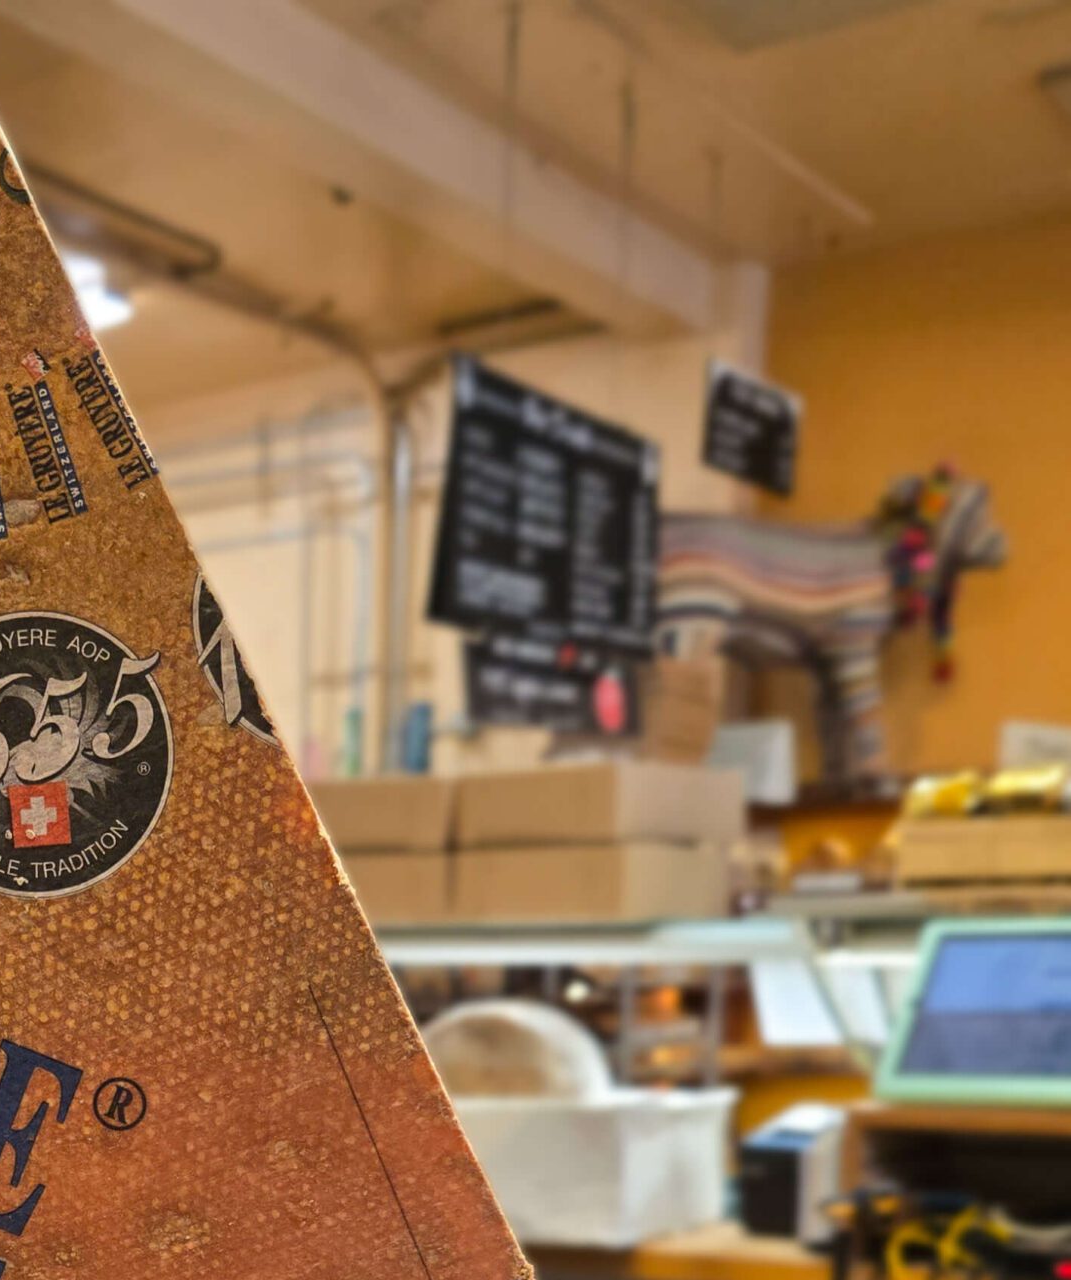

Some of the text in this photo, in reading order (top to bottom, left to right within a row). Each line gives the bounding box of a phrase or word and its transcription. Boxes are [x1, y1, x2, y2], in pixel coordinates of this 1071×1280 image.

[38, 387, 84, 508] SWITZERLAND
[117, 455, 152, 490] LE
[42, 492, 74, 525] LE
[66, 634, 112, 666] AOP
[29, 818, 130, 880] TRADITION
